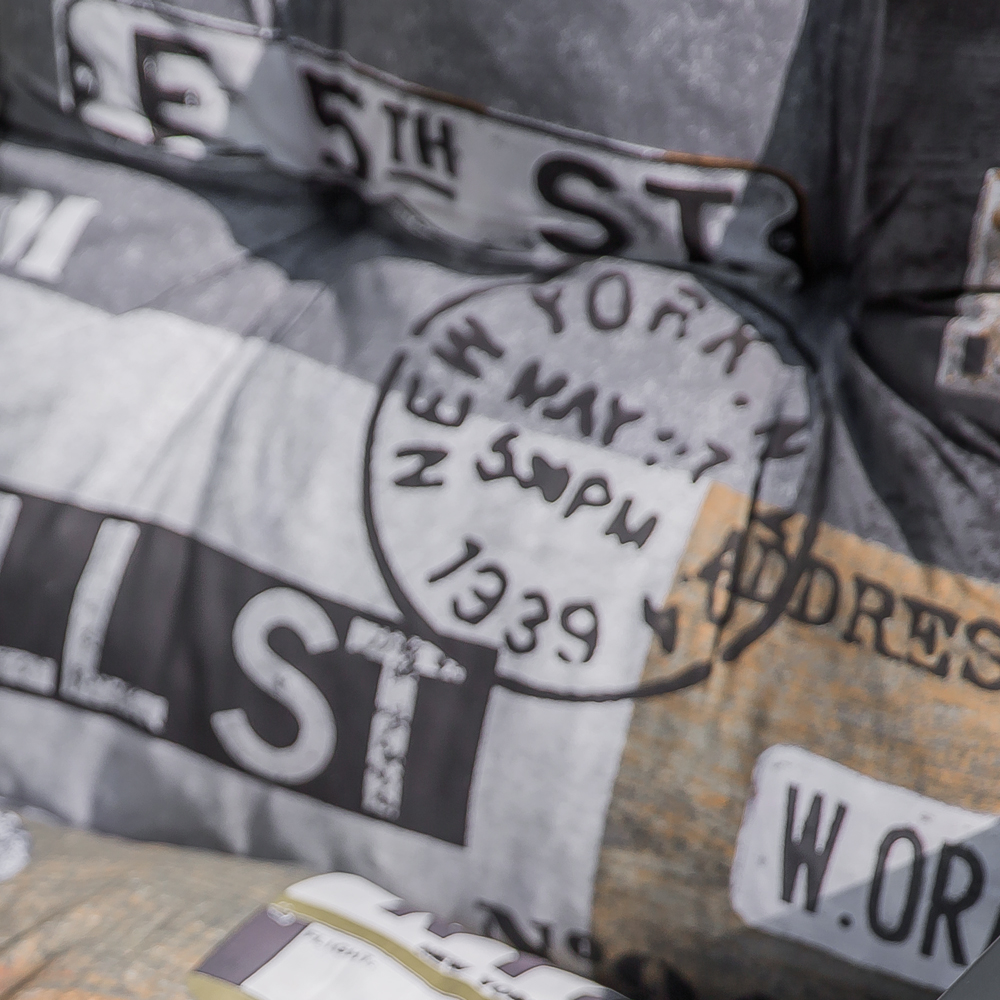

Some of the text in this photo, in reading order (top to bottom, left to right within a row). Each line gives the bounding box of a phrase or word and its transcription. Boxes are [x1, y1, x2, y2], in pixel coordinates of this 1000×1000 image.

[394, 316, 504, 488] NEW
[508, 361, 644, 446] MAY
[209, 586, 468, 822] ST
